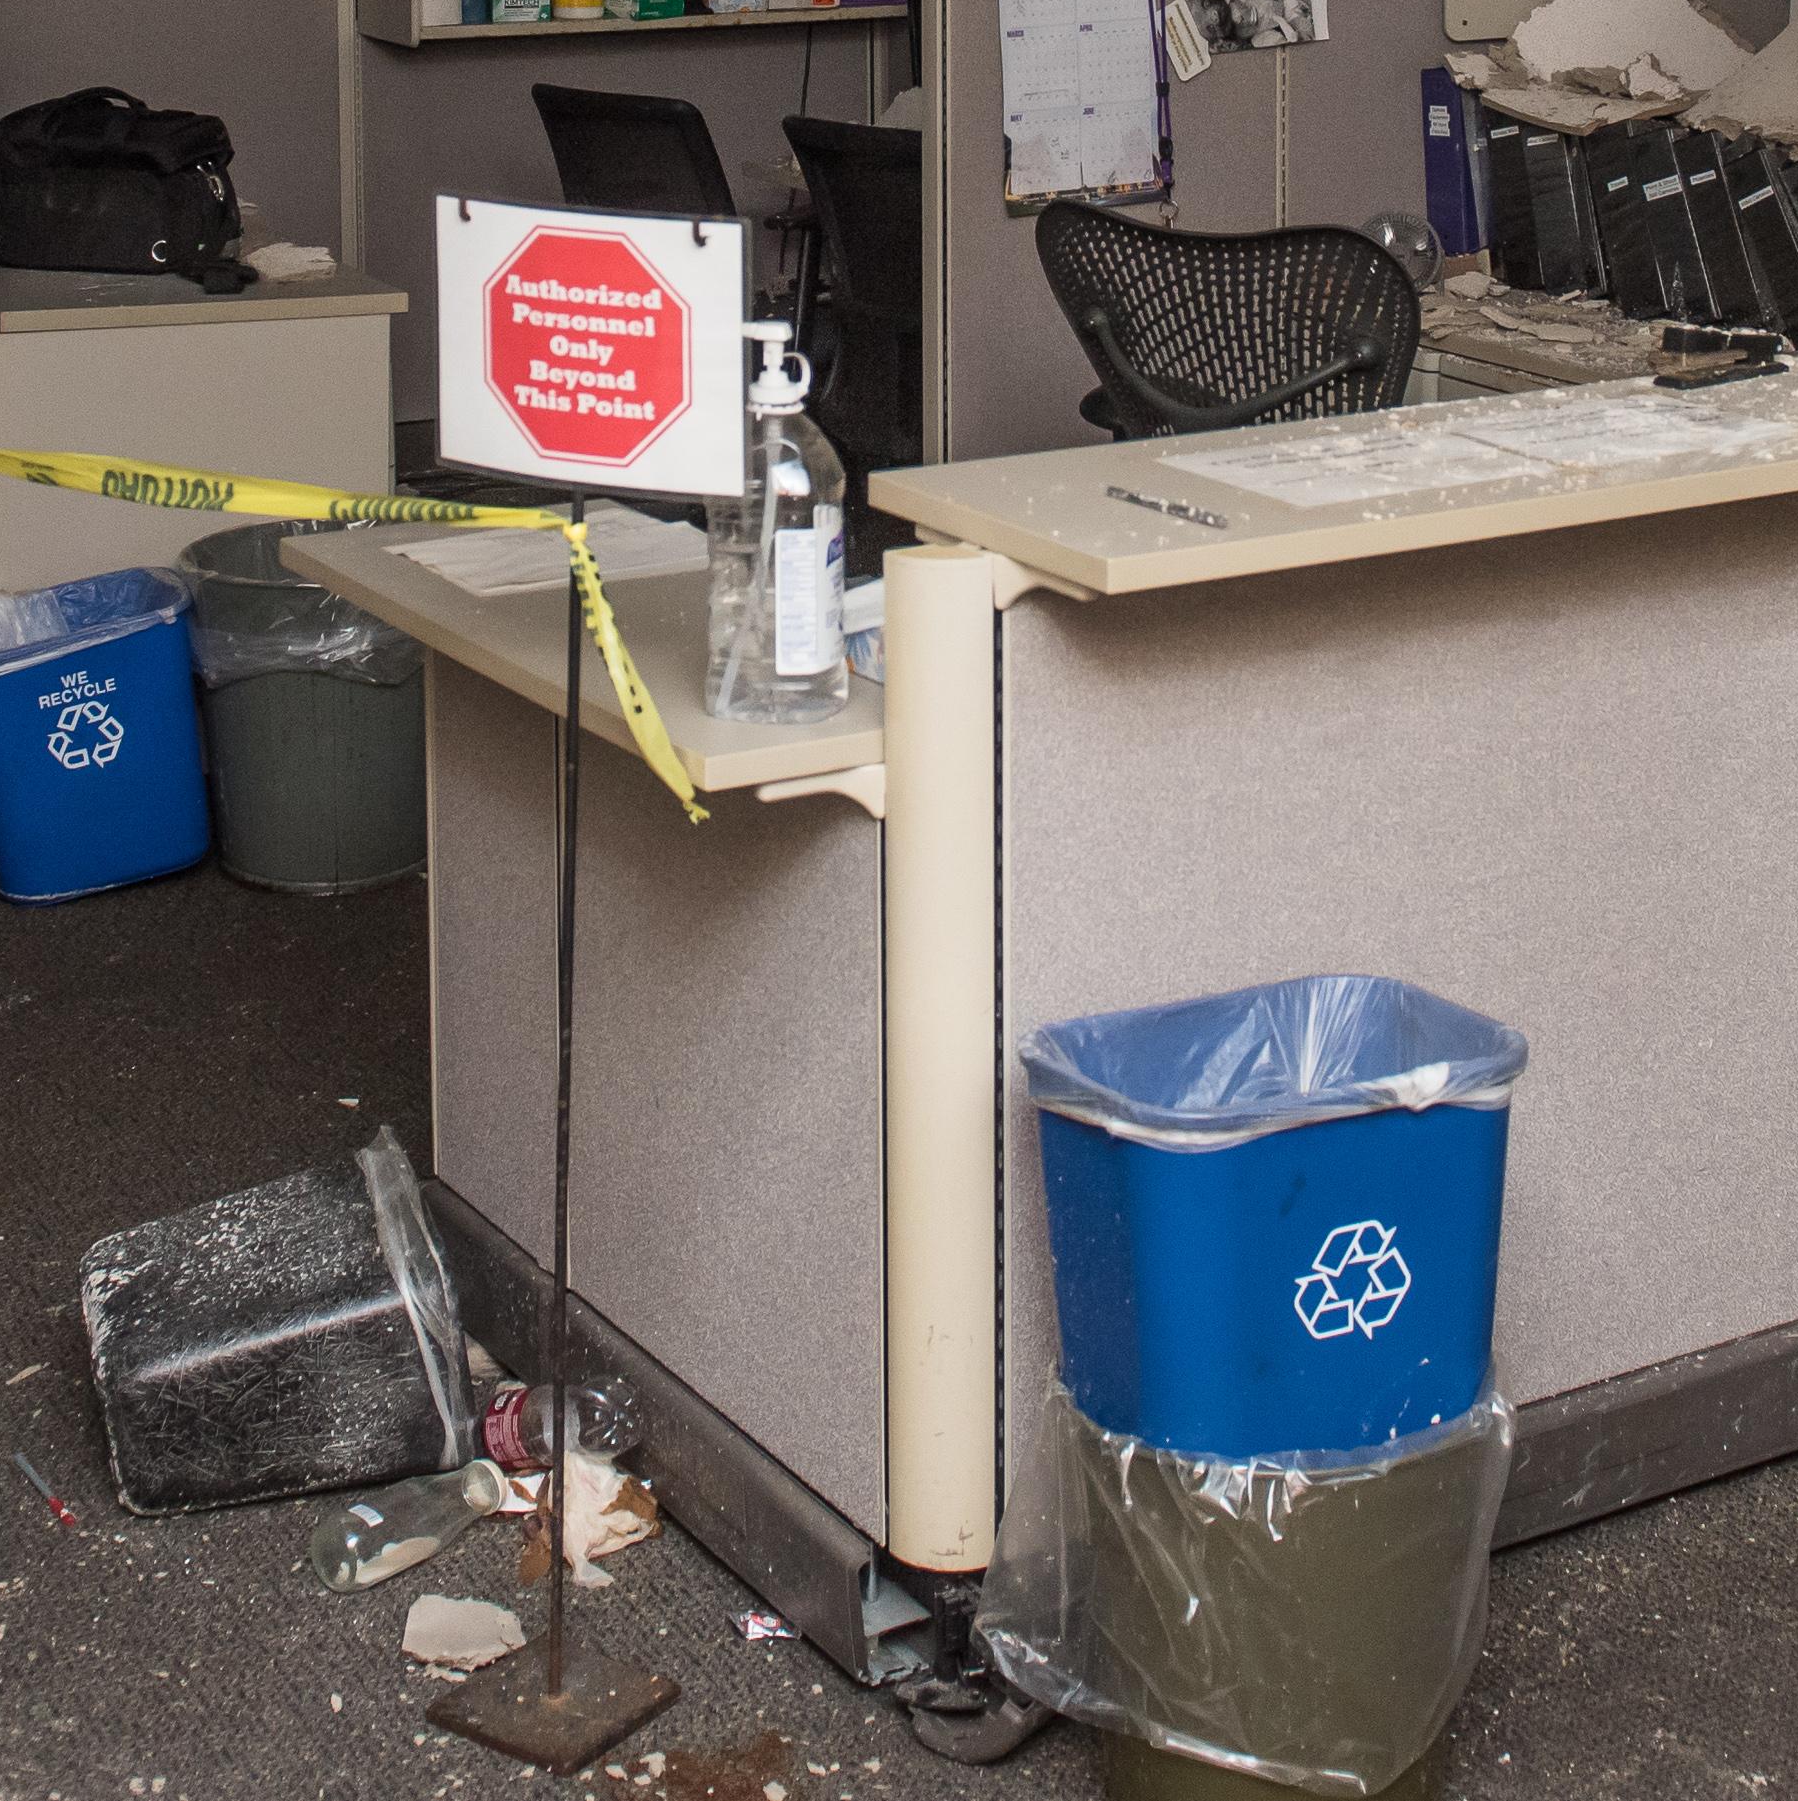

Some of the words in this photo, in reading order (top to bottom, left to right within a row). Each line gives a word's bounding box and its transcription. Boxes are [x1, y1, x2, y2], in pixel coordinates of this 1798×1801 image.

[505, 274, 662, 310] Authorized
[512, 302, 656, 338] Personnel
[549, 335, 613, 366] Only
[530, 359, 636, 392] Beyond
[514, 384, 572, 413] This
[577, 392, 656, 421] Point
[38, 677, 117, 710] RECYCLE
[60, 670, 89, 689] WE
